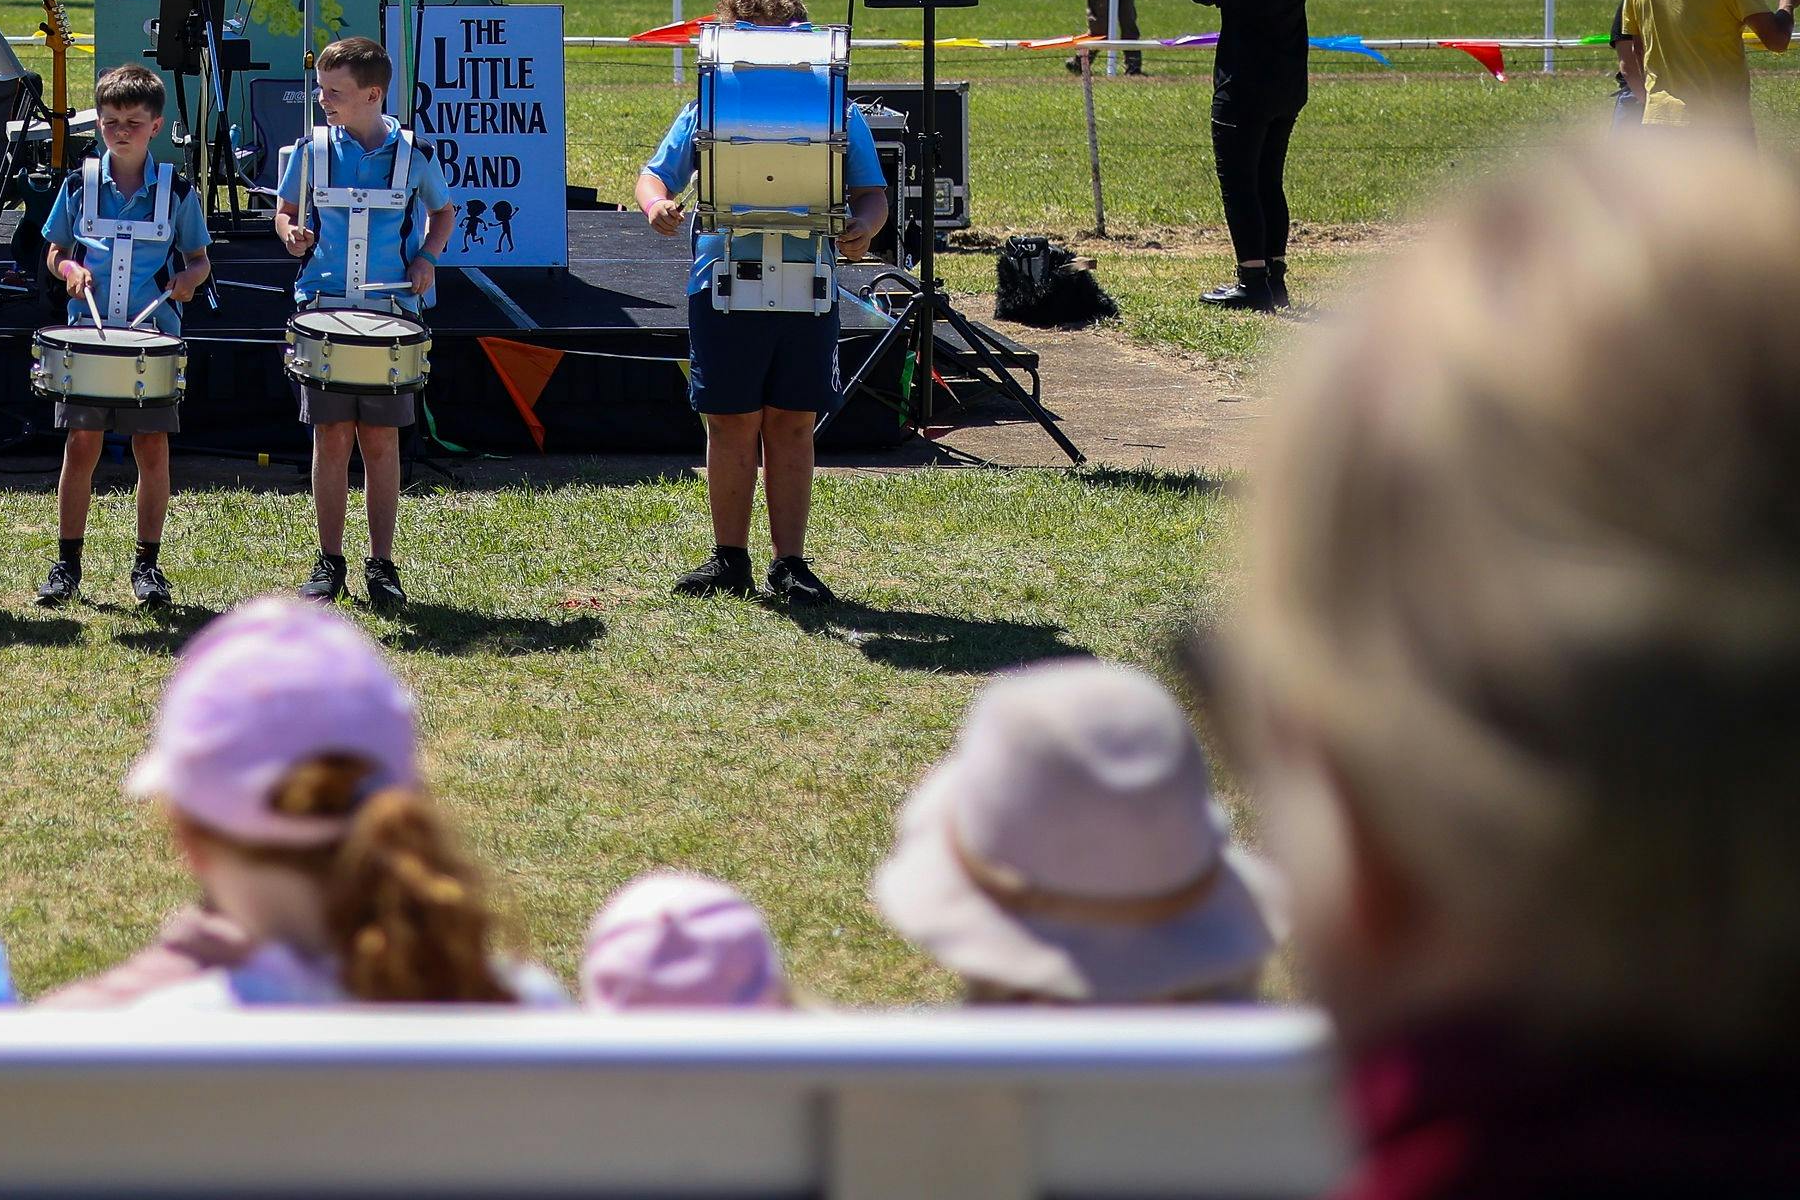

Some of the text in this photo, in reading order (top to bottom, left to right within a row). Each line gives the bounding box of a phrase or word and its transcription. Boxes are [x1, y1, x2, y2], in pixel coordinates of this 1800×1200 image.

[459, 19, 507, 53] THE
[433, 36, 535, 100] LITTLE
[415, 81, 548, 134] RIVERINA
[435, 139, 521, 188] BAND
